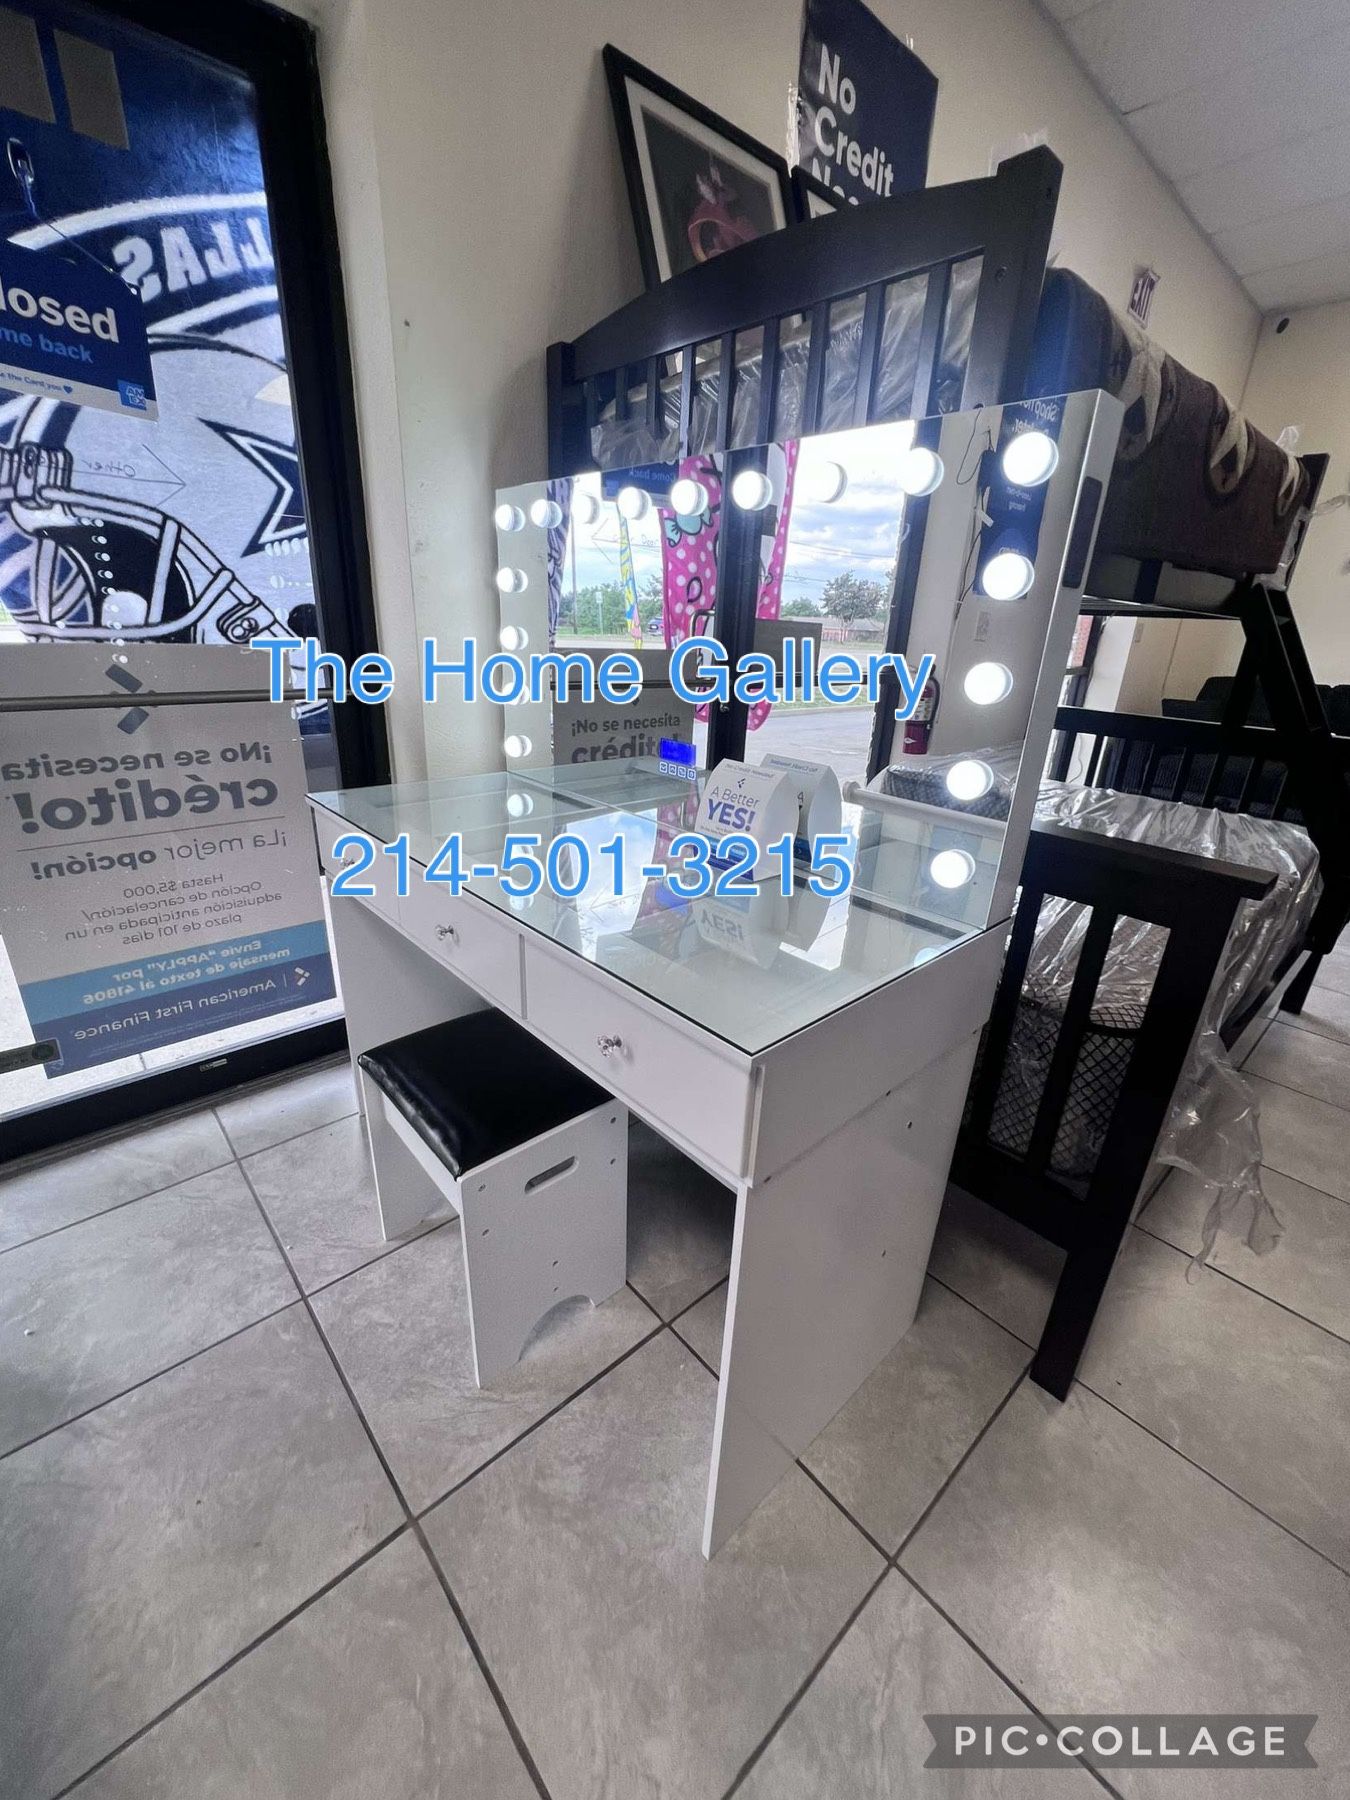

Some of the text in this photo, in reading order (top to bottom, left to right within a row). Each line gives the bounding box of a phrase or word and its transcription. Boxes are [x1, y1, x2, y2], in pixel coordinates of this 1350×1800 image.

[818, 43, 857, 115] No
[814, 106, 894, 198] Credit
[38, 333, 94, 364] back
[603, 720, 619, 732] se
[623, 712, 680, 730] necesita
[571, 733, 681, 764] crédit
[711, 786, 760, 808] A Better
[708, 798, 756, 832] YES!
